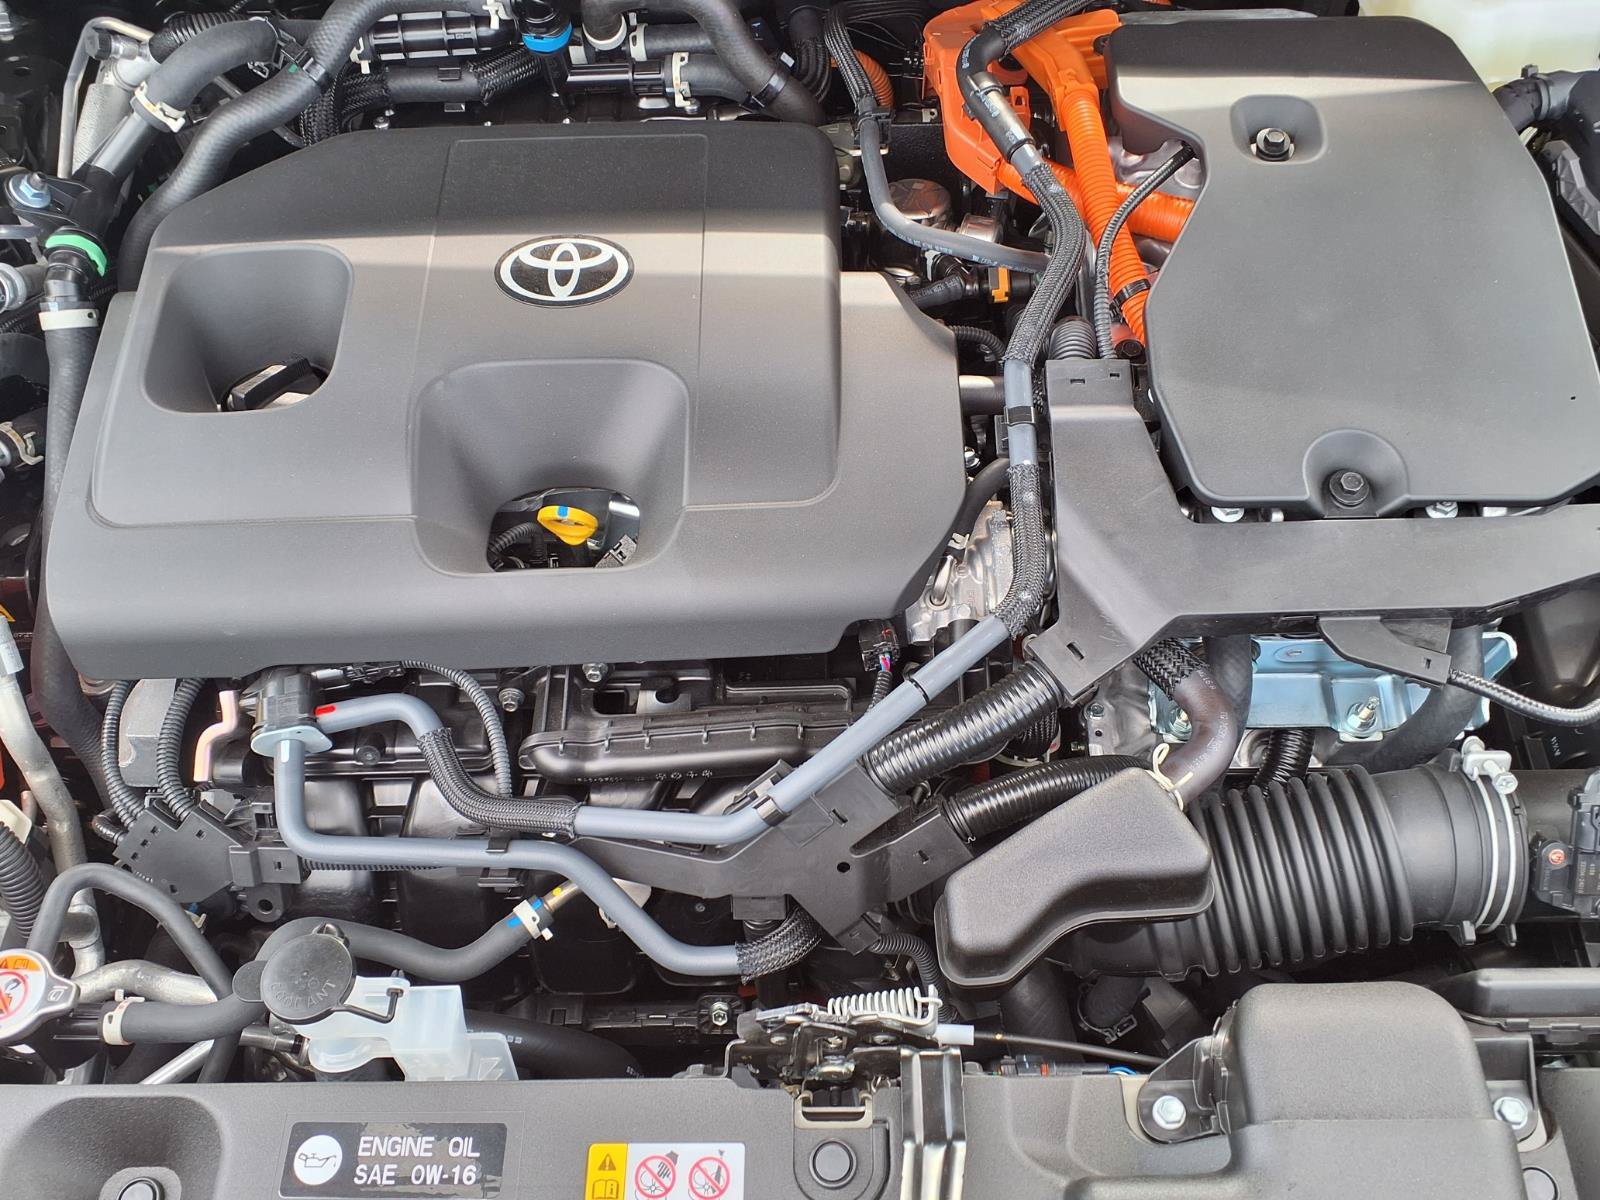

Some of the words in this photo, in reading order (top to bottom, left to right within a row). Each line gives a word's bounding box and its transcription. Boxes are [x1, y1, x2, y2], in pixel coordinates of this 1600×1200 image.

[270, 979, 337, 1009] COOLANT
[358, 1136, 435, 1157] ENGINE
[448, 1136, 481, 1157] OIL
[353, 1164, 397, 1185] SAE
[411, 1164, 477, 1186] 0W-16
